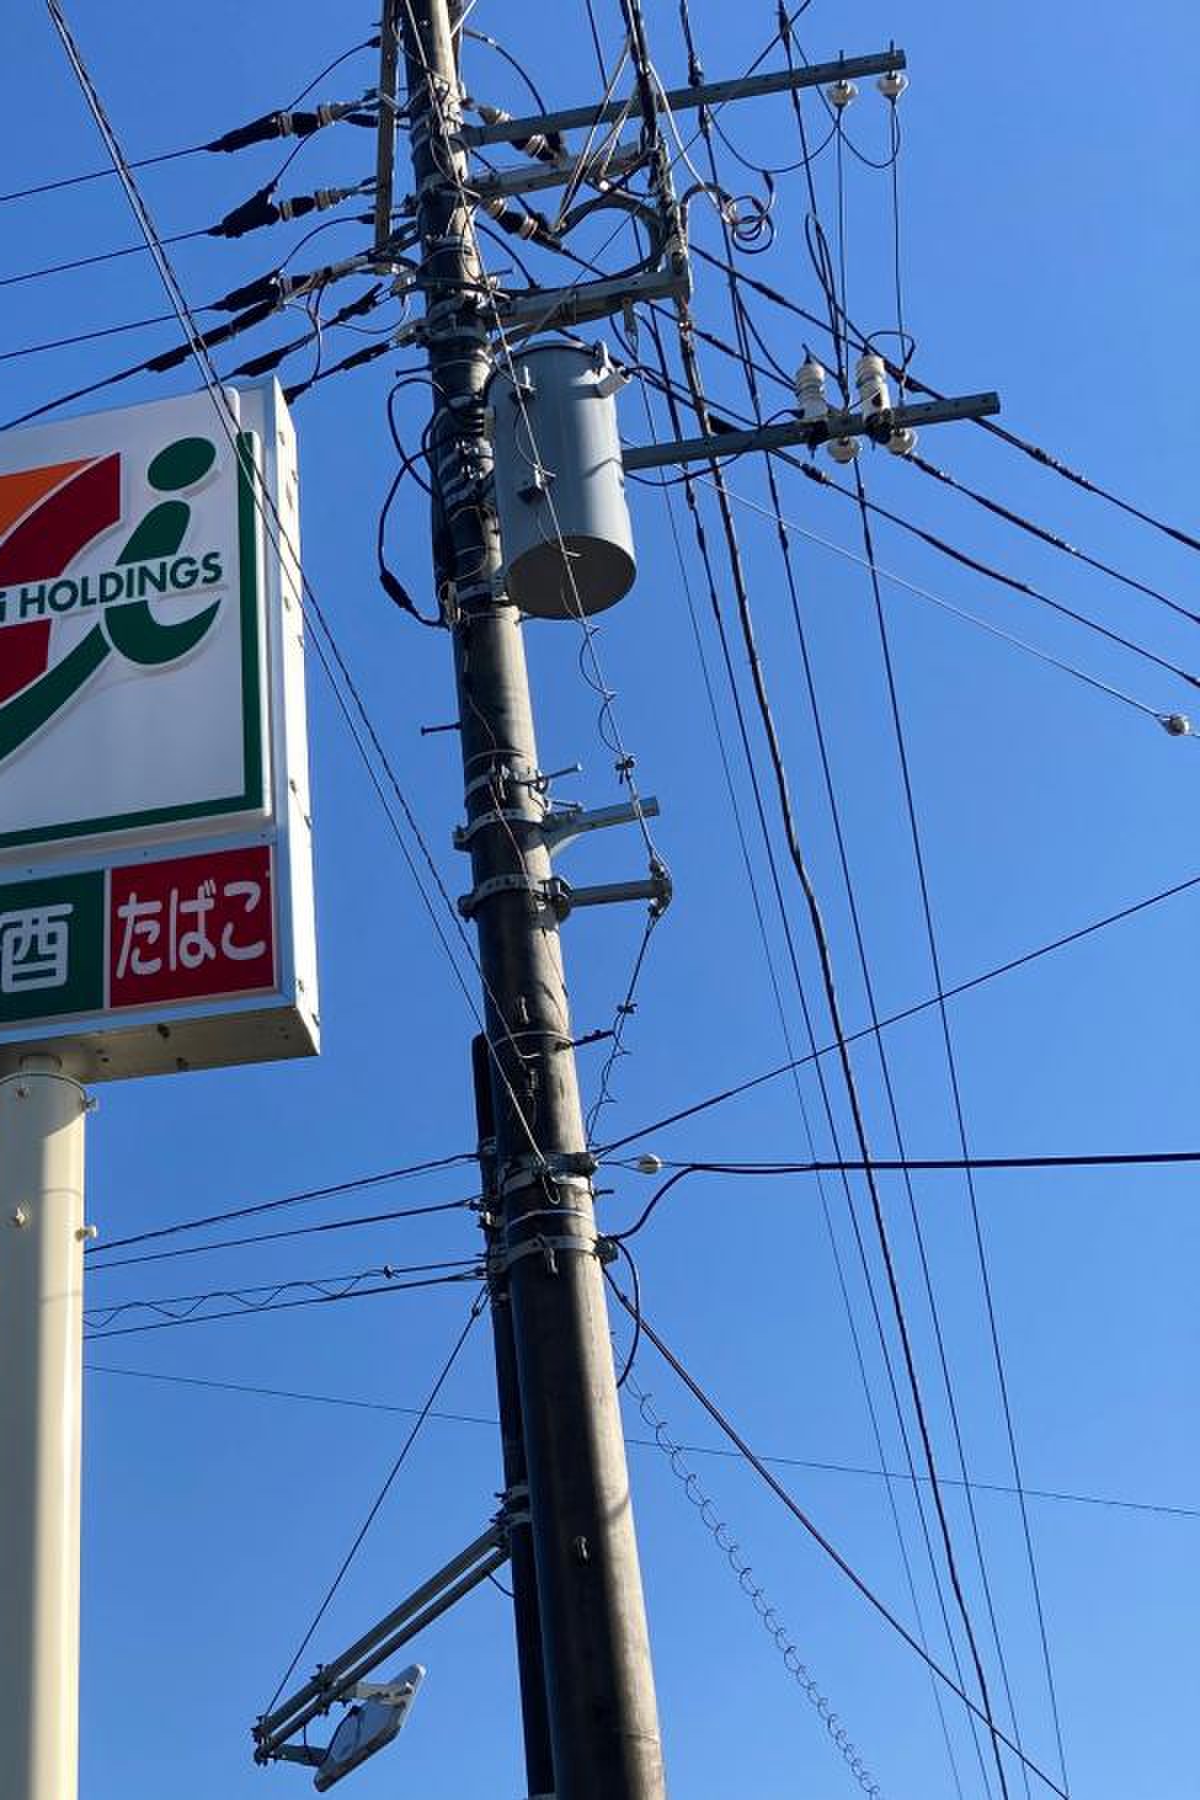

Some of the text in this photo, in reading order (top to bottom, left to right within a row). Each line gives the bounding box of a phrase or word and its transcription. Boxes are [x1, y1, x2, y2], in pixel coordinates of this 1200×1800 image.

[19, 551, 223, 618] HOLDINGS
[117, 879, 266, 979] たばこ
